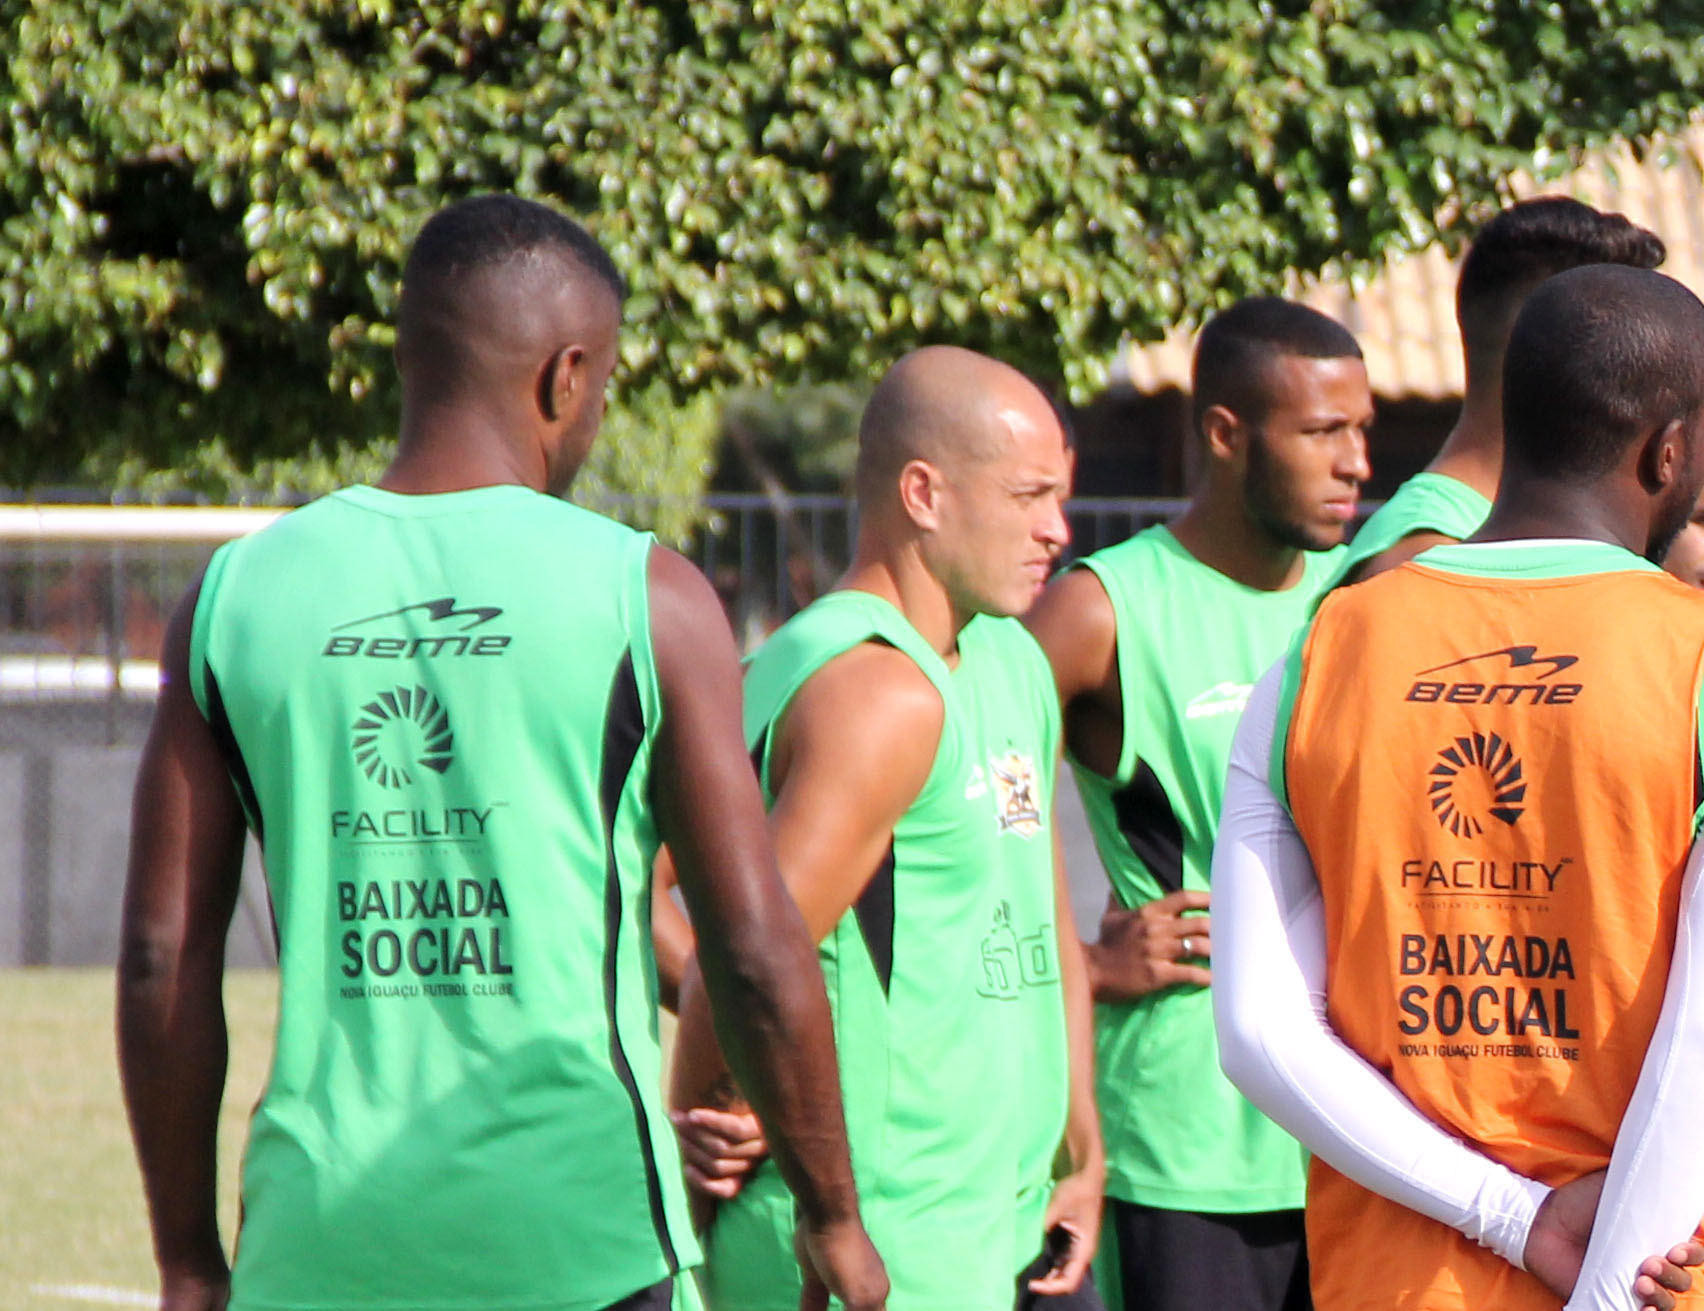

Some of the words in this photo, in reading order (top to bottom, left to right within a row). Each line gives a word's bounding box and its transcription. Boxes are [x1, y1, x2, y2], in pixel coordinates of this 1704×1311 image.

[331, 807, 494, 839] FACILITY
[1402, 859, 1563, 892] FACILITY
[338, 877, 511, 923] BAIXADA
[339, 927, 514, 980] SOCIAL
[1400, 933, 1577, 981] BAIXADA
[1398, 984, 1580, 1040] SOCIAL
[1398, 1044, 1432, 1058] NOVA
[1537, 1045, 1580, 1062] CLUBE
